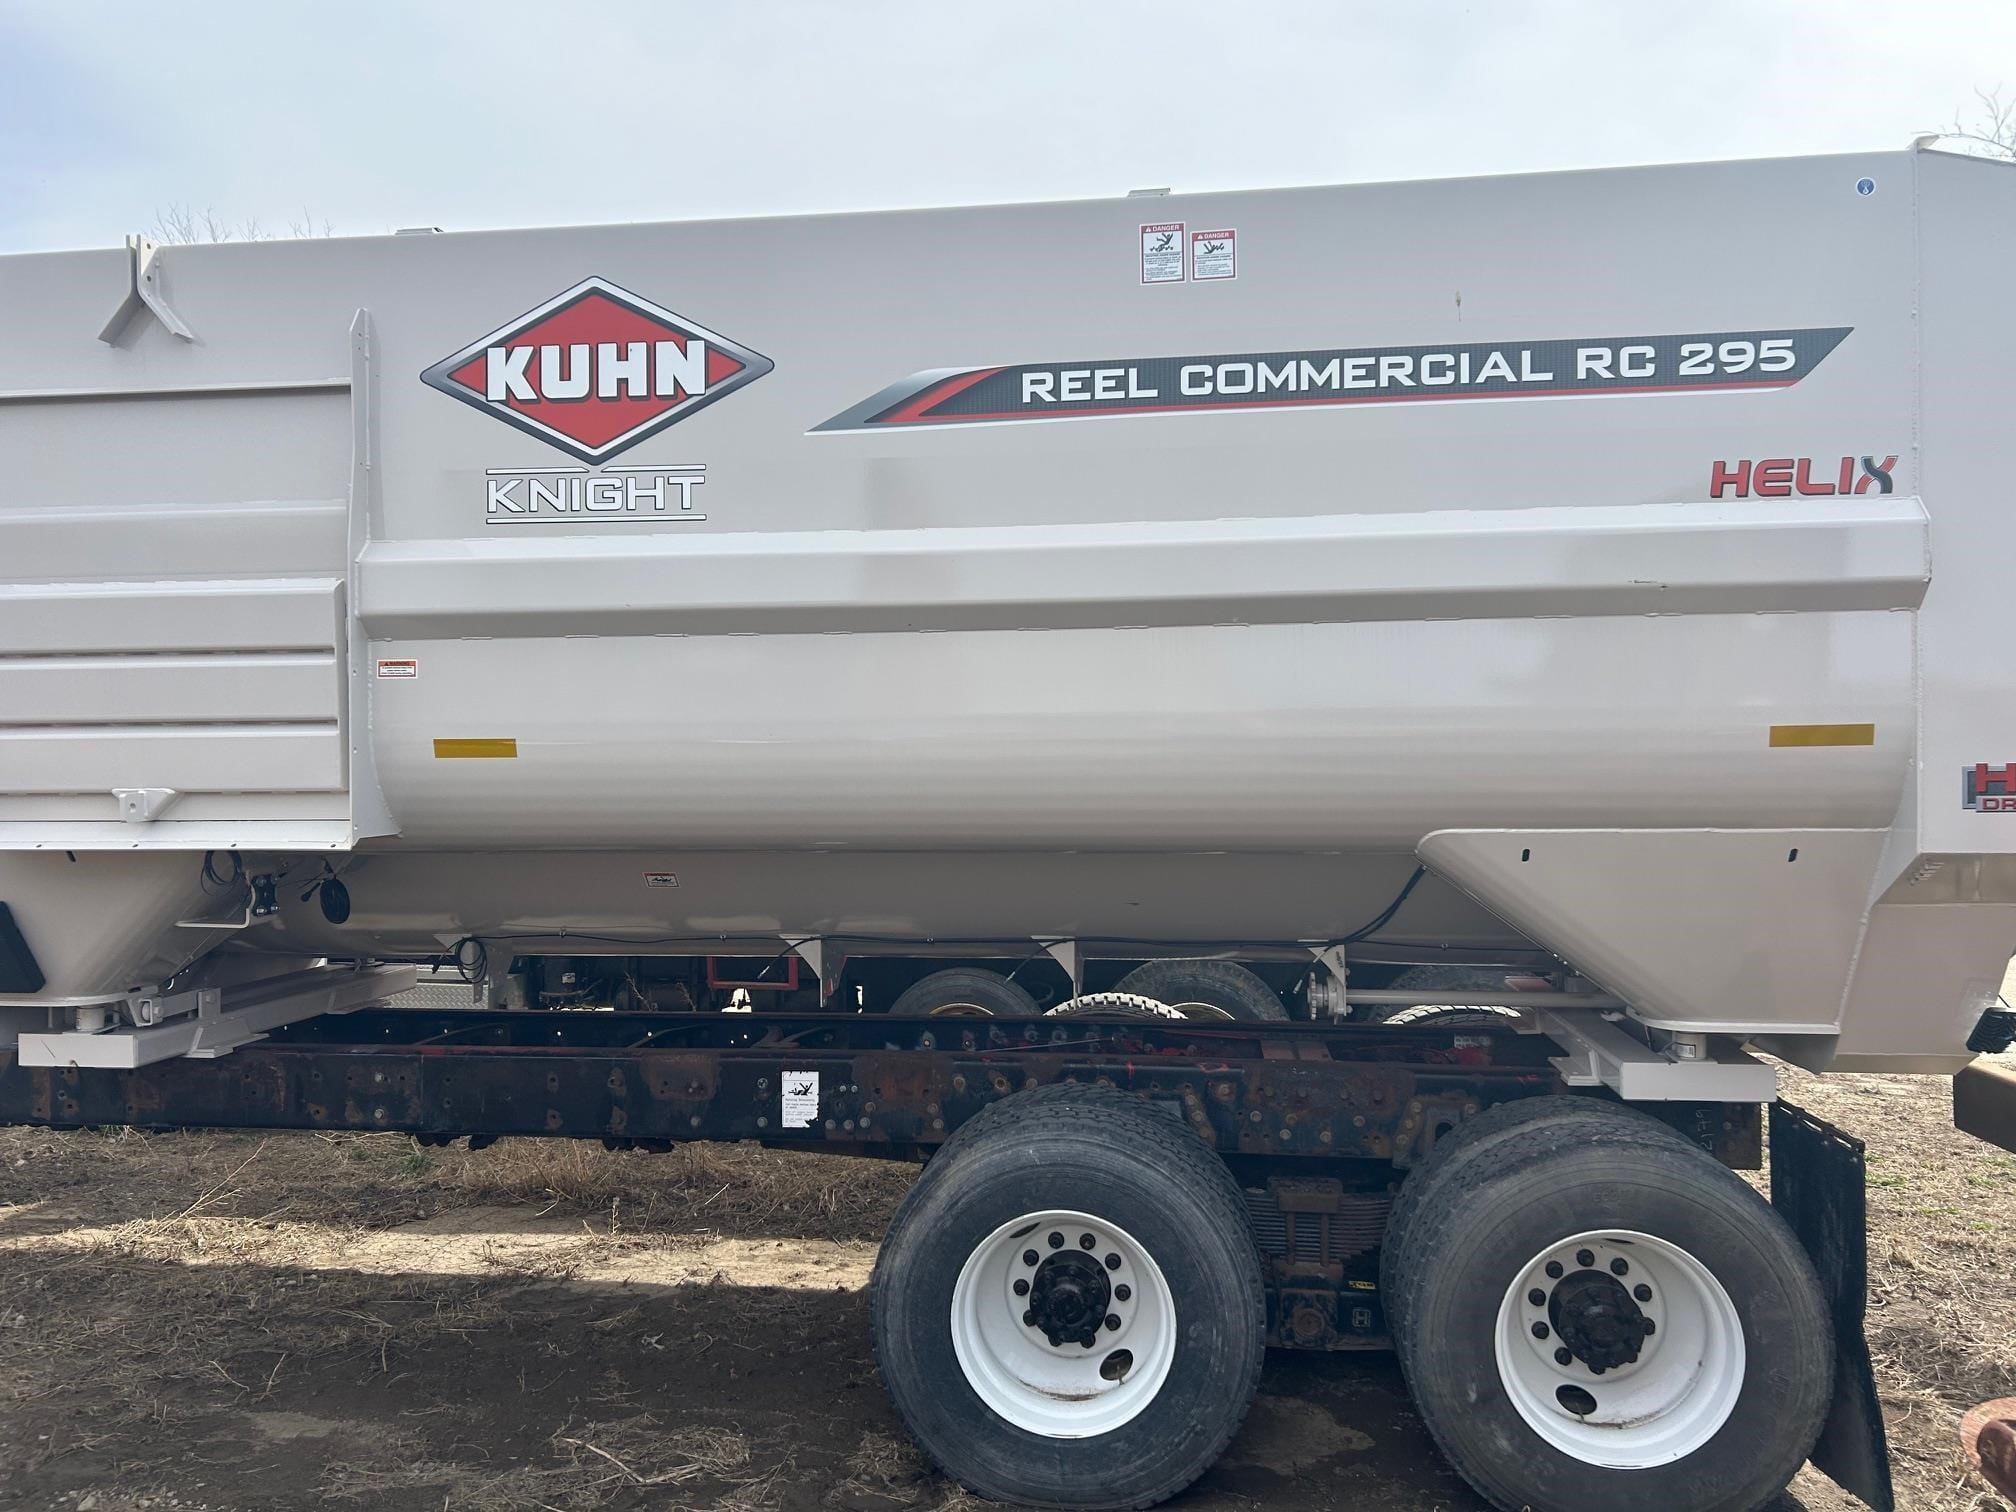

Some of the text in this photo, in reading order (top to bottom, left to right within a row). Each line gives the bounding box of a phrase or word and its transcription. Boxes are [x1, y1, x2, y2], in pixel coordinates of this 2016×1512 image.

[1152, 224, 1180, 232] DANGER
[486, 340, 706, 402] KUHN
[1022, 338, 1797, 403] REEL COMMERCIAL RC 295
[486, 475, 706, 514] KNIGHT
[1709, 455, 1899, 499] HELIX
